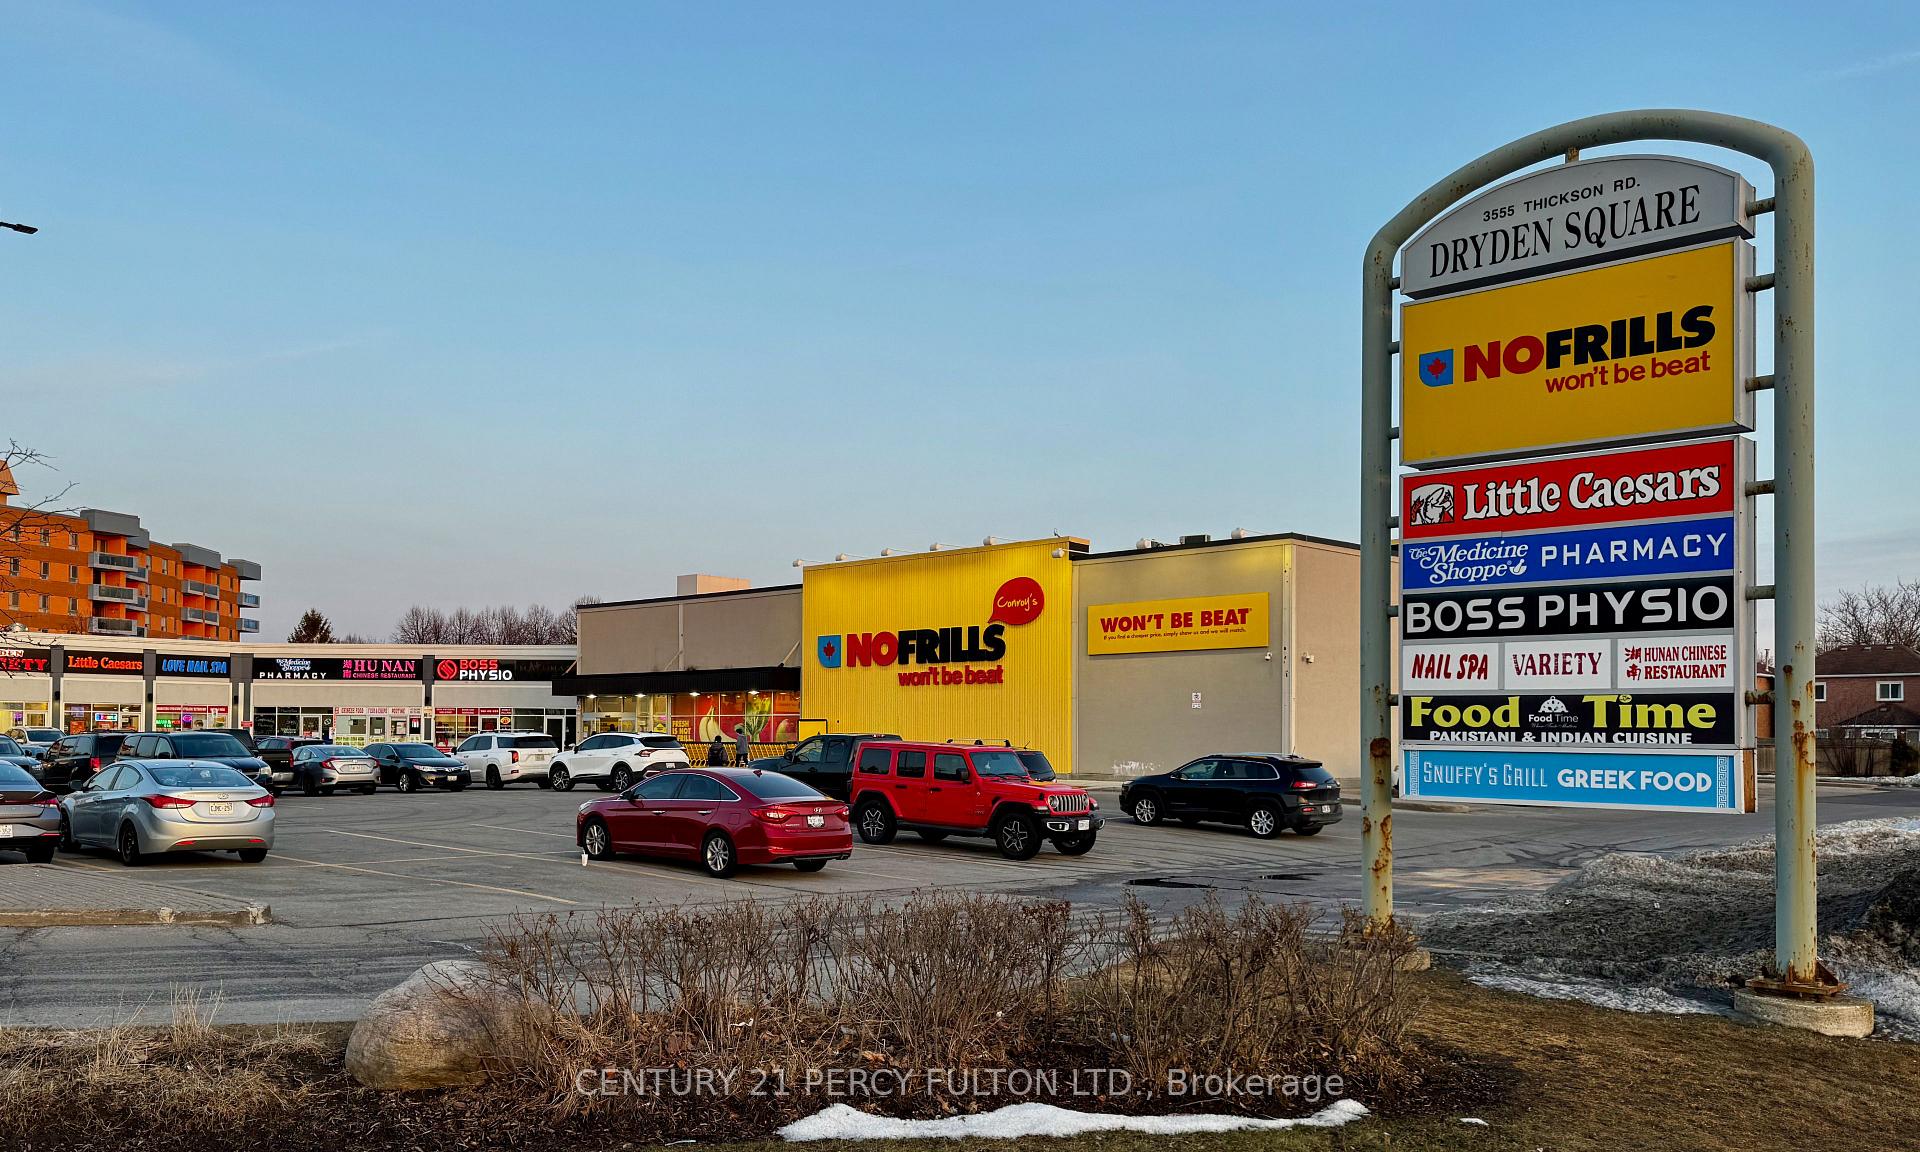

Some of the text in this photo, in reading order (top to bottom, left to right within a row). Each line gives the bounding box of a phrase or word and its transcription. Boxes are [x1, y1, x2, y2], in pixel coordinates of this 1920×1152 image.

[1483, 176, 1641, 222] 3555 THICKSON RD.
[1429, 184, 1701, 278] DRYDEN SQUARE
[1545, 351, 1711, 393] won't be beat
[1462, 465, 1721, 521] Little Caesars
[1409, 540, 1529, 569] The Medicine
[1541, 532, 1727, 568] PHARMACY
[1429, 559, 1509, 584] Shoppe
[996, 593, 1038, 611] Conroy's
[1406, 585, 1728, 634] BOSS PHYSIO
[1100, 608, 1249, 633] WON'T BE BEAT
[68, 655, 142, 670] Little Caesars
[459, 659, 498, 670] BOSS
[1512, 651, 1603, 677] VARIETY
[1644, 644, 1727, 662] HUNAN CHINESE
[162, 659, 185, 672] LOVE
[209, 661, 227, 674] SPA
[259, 671, 327, 679] PHARMACY
[459, 670, 513, 681] PHYSIO
[898, 664, 1004, 687] won't be beat
[1411, 653, 1489, 681] NAIL SPA
[1644, 663, 1727, 680] RESTAURANT
[1410, 694, 1718, 729] Food Time
[1528, 713, 1579, 723] Food Time
[1429, 731, 1692, 744] PAKISTANI & INDIAN CUISINE
[1503, 763, 1548, 788] GRILL
[1557, 768, 1636, 791] GREEK
[1640, 771, 1712, 793] FOOD
